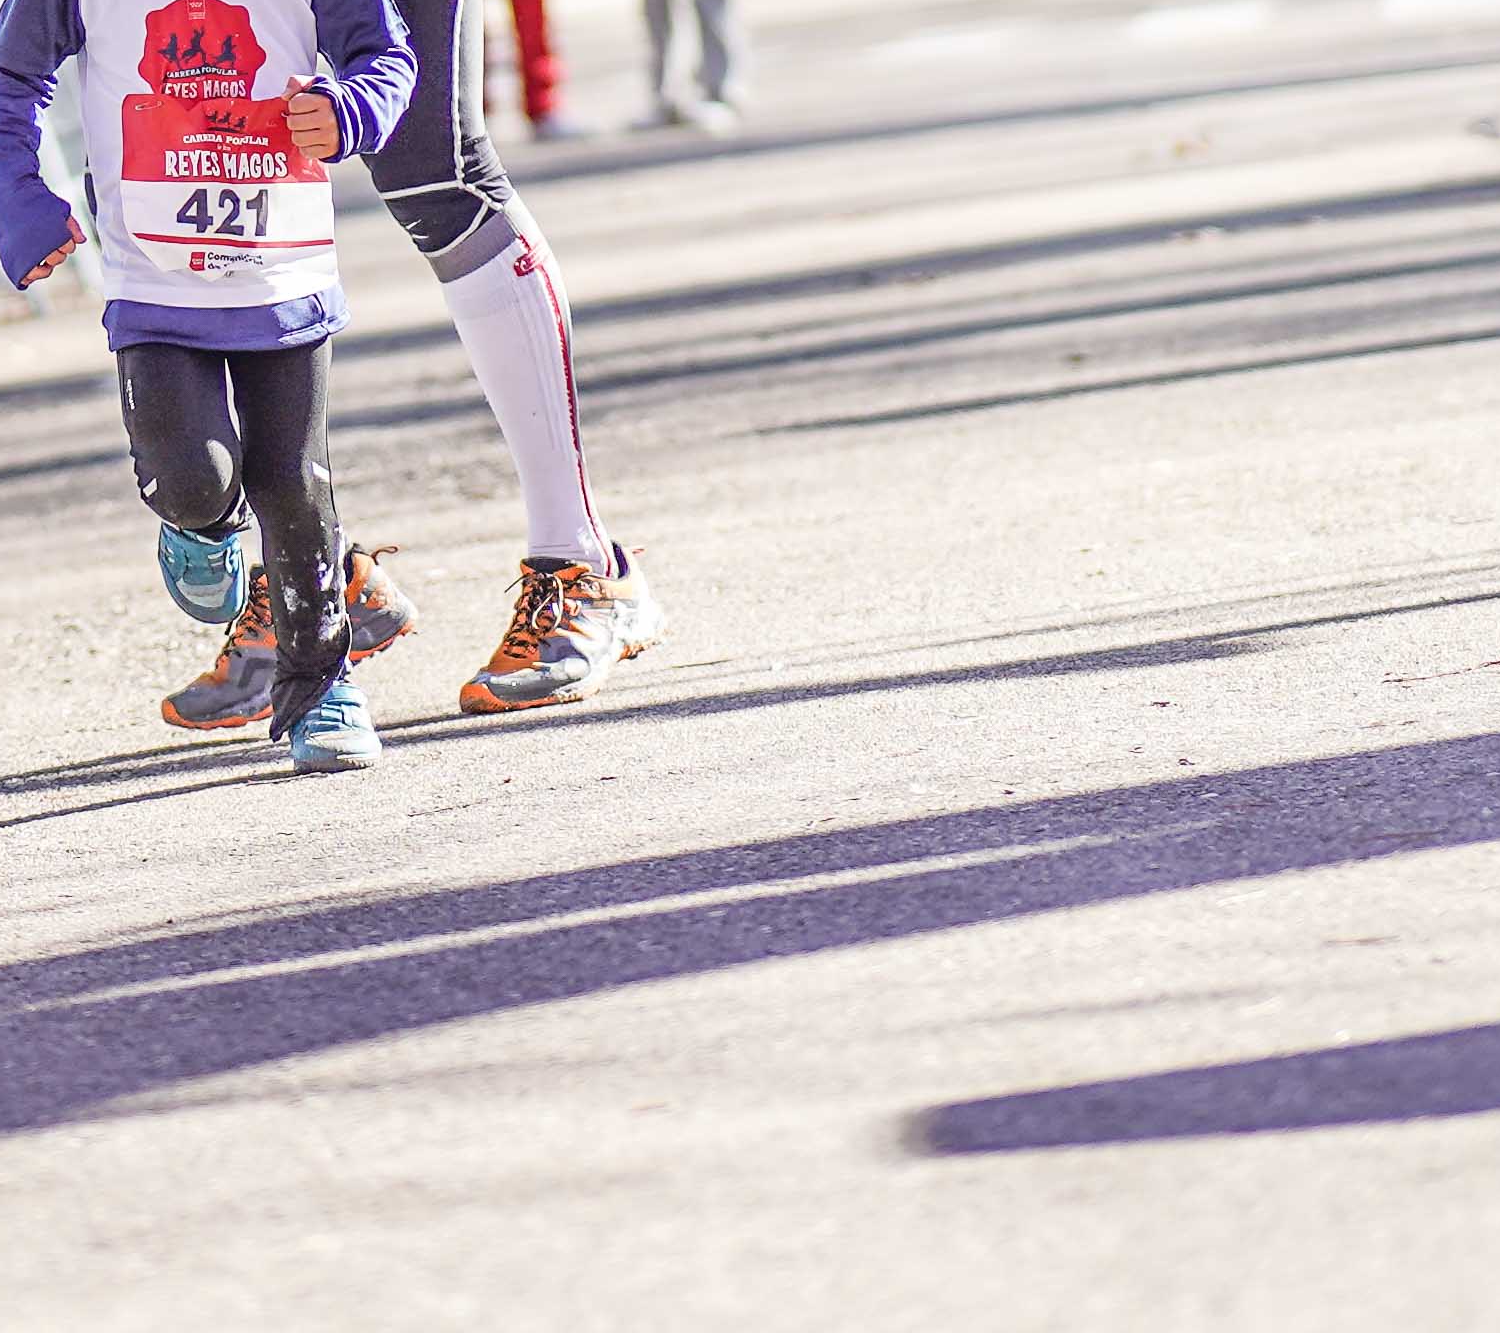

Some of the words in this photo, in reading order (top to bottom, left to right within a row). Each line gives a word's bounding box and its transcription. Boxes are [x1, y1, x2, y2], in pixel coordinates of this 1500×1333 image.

[167, 68, 201, 78] CARRERA
[202, 66, 238, 76] POPULAR
[164, 82, 198, 99] EYES
[203, 79, 246, 99] MAGOS
[164, 149, 221, 178] REYES
[222, 151, 288, 180] MAGOS
[176, 188, 269, 237] 421
